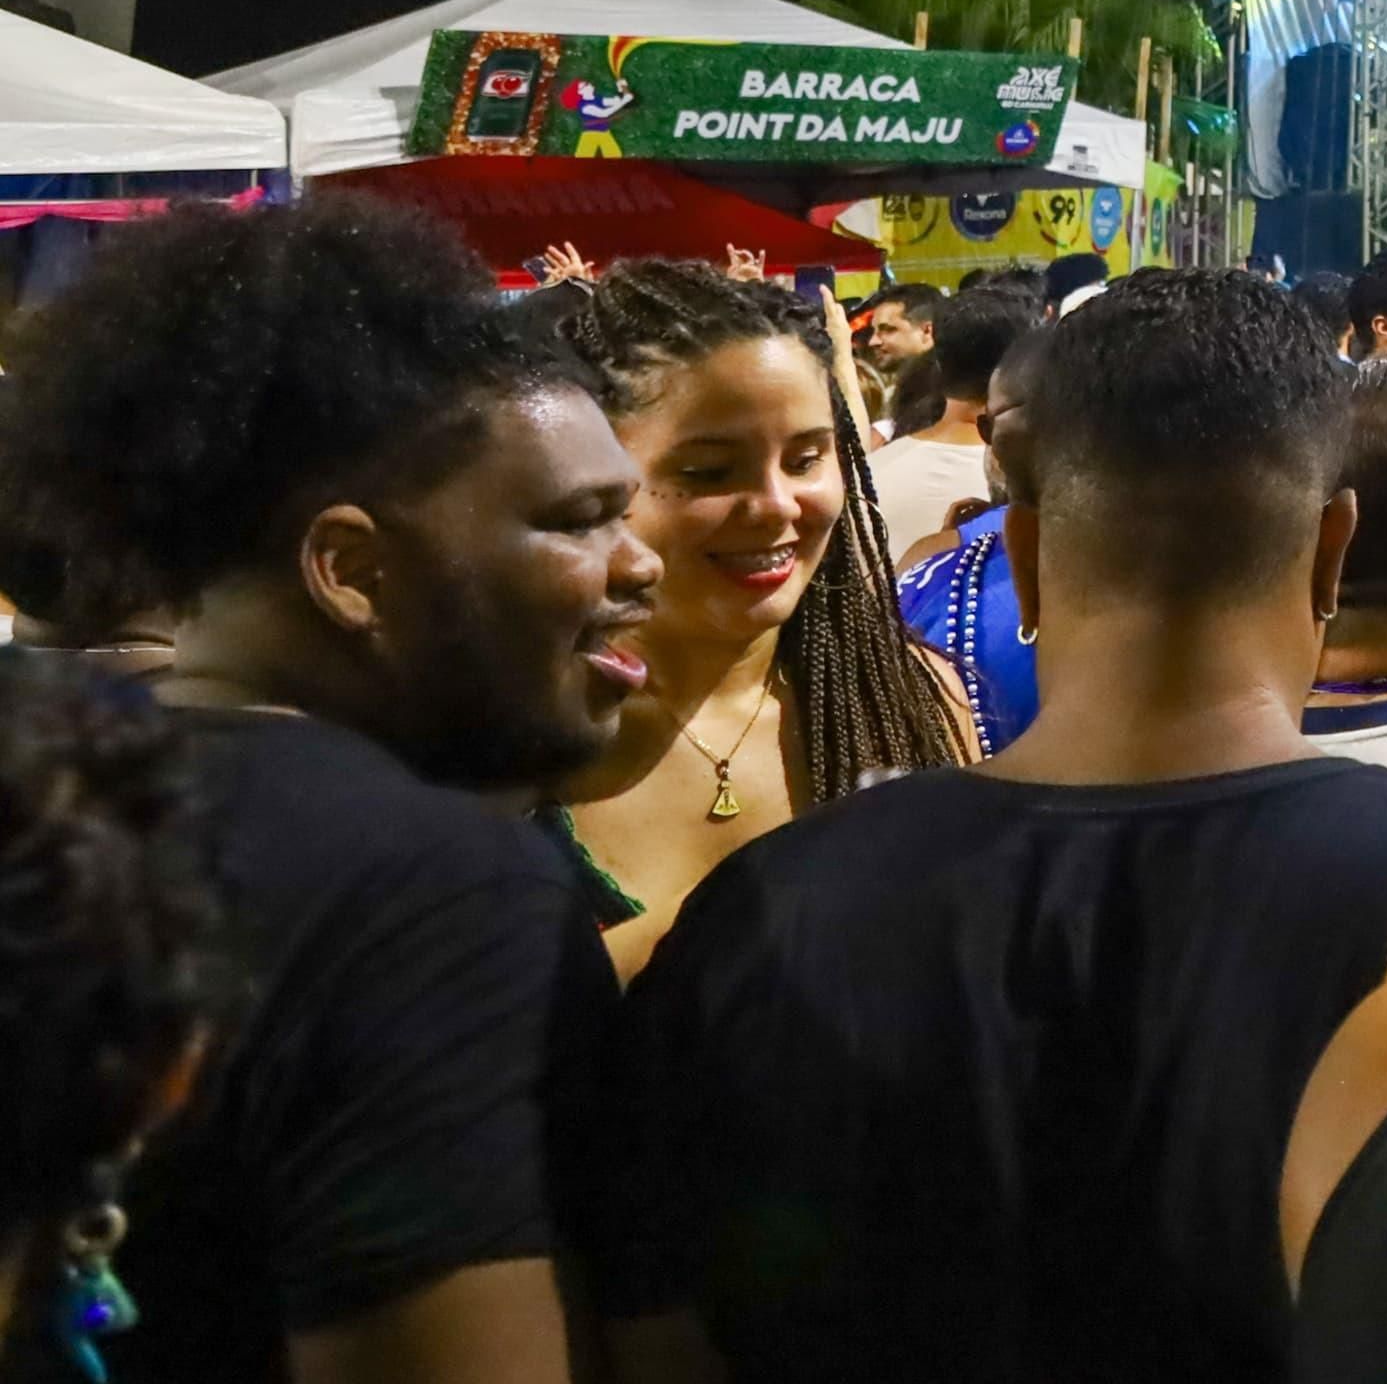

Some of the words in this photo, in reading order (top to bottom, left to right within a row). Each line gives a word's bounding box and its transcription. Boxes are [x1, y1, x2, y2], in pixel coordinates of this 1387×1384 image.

[739, 69, 921, 103] BARRACA
[673, 110, 794, 141] POINT
[794, 113, 848, 143] DA
[854, 116, 964, 145] MAJU
[1049, 194, 1076, 226] 99
